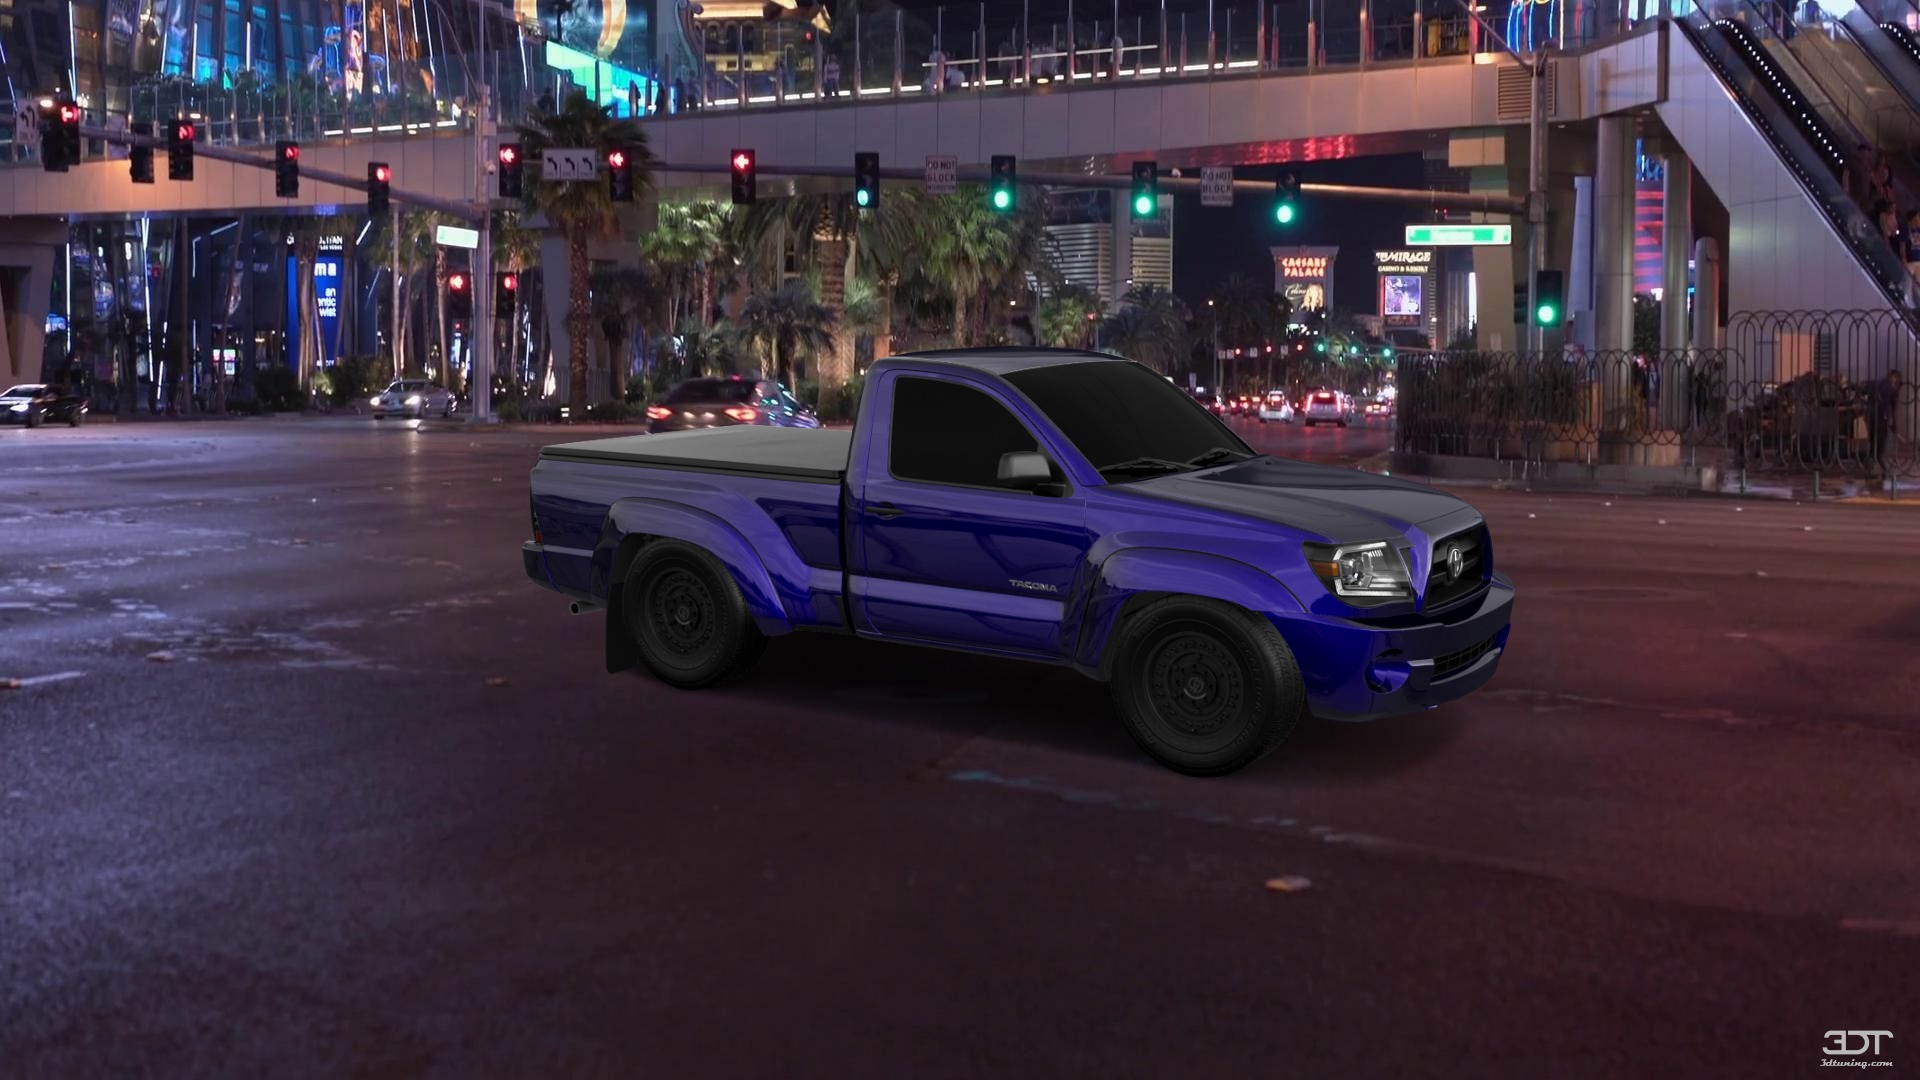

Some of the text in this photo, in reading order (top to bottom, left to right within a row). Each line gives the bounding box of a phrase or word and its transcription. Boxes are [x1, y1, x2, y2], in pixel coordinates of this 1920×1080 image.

[1202, 184, 1231, 193] BLOCK
[1281, 257, 1327, 267] CAESARS
[1388, 251, 1431, 263] MIRAGE
[1284, 267, 1324, 277] PALACE
[1009, 579, 1058, 592] TACOMA
